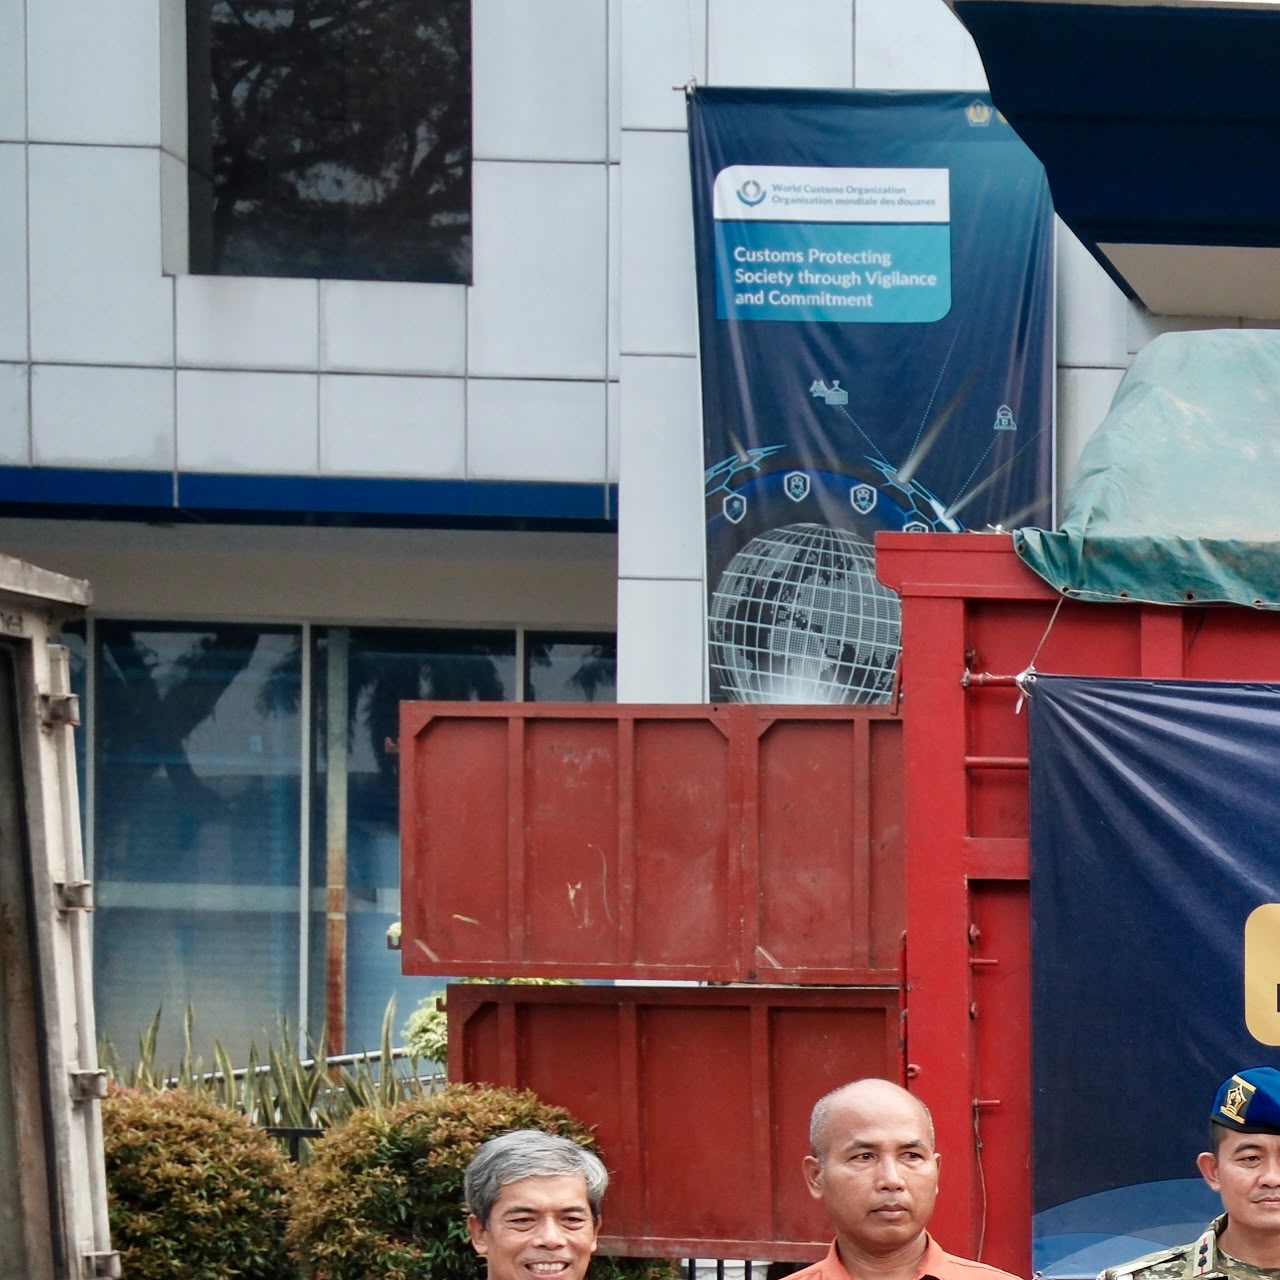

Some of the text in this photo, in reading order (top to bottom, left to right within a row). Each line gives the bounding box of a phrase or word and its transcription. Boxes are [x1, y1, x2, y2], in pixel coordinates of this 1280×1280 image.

[772, 184, 906, 197] World Customs Organization
[734, 246, 892, 268] Customs Protecting
[735, 268, 937, 289] Society through Vigilance
[735, 289, 873, 308] and Commitment
